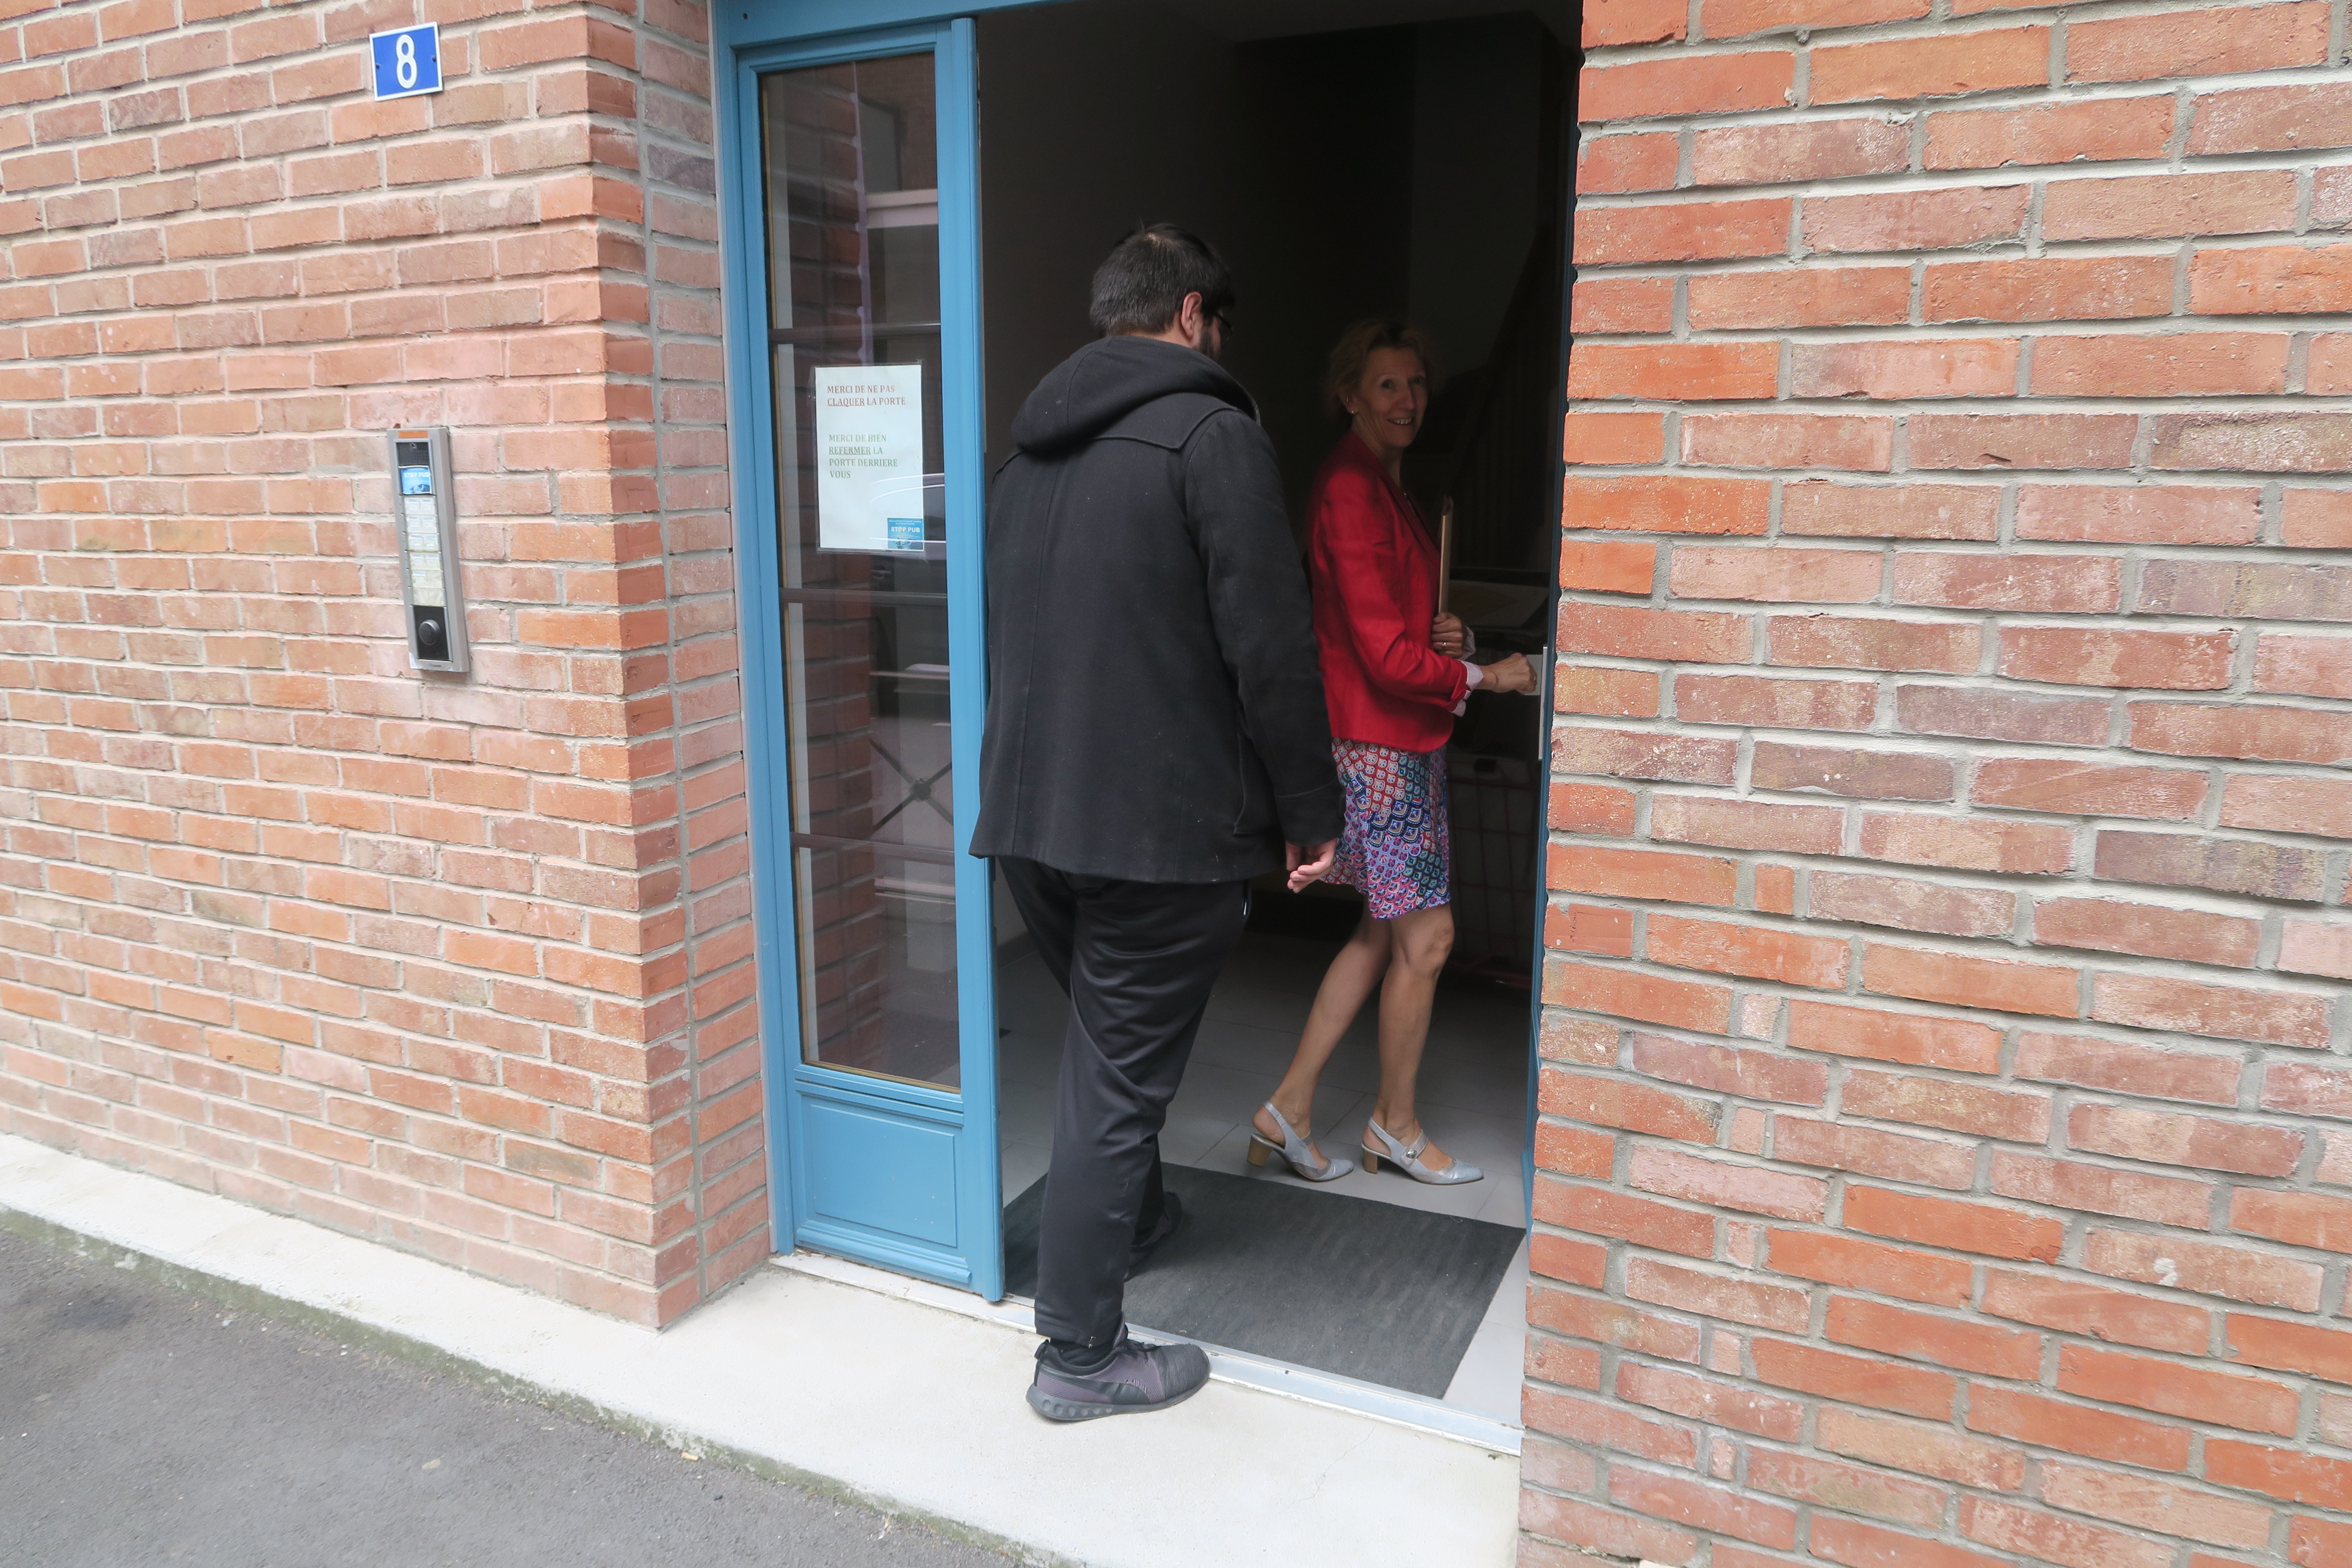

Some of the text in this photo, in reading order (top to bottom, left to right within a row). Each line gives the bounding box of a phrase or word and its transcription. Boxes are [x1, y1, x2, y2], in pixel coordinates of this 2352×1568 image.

[395, 34, 418, 89] 8
[827, 386, 853, 394] MERCI
[855, 385, 865, 393] DE
[880, 385, 895, 393] PAS
[827, 398, 865, 407] CLAQUER
[879, 397, 905, 405] PORTE
[829, 447, 871, 455] REFERMER
[829, 458, 856, 466] PORTE
